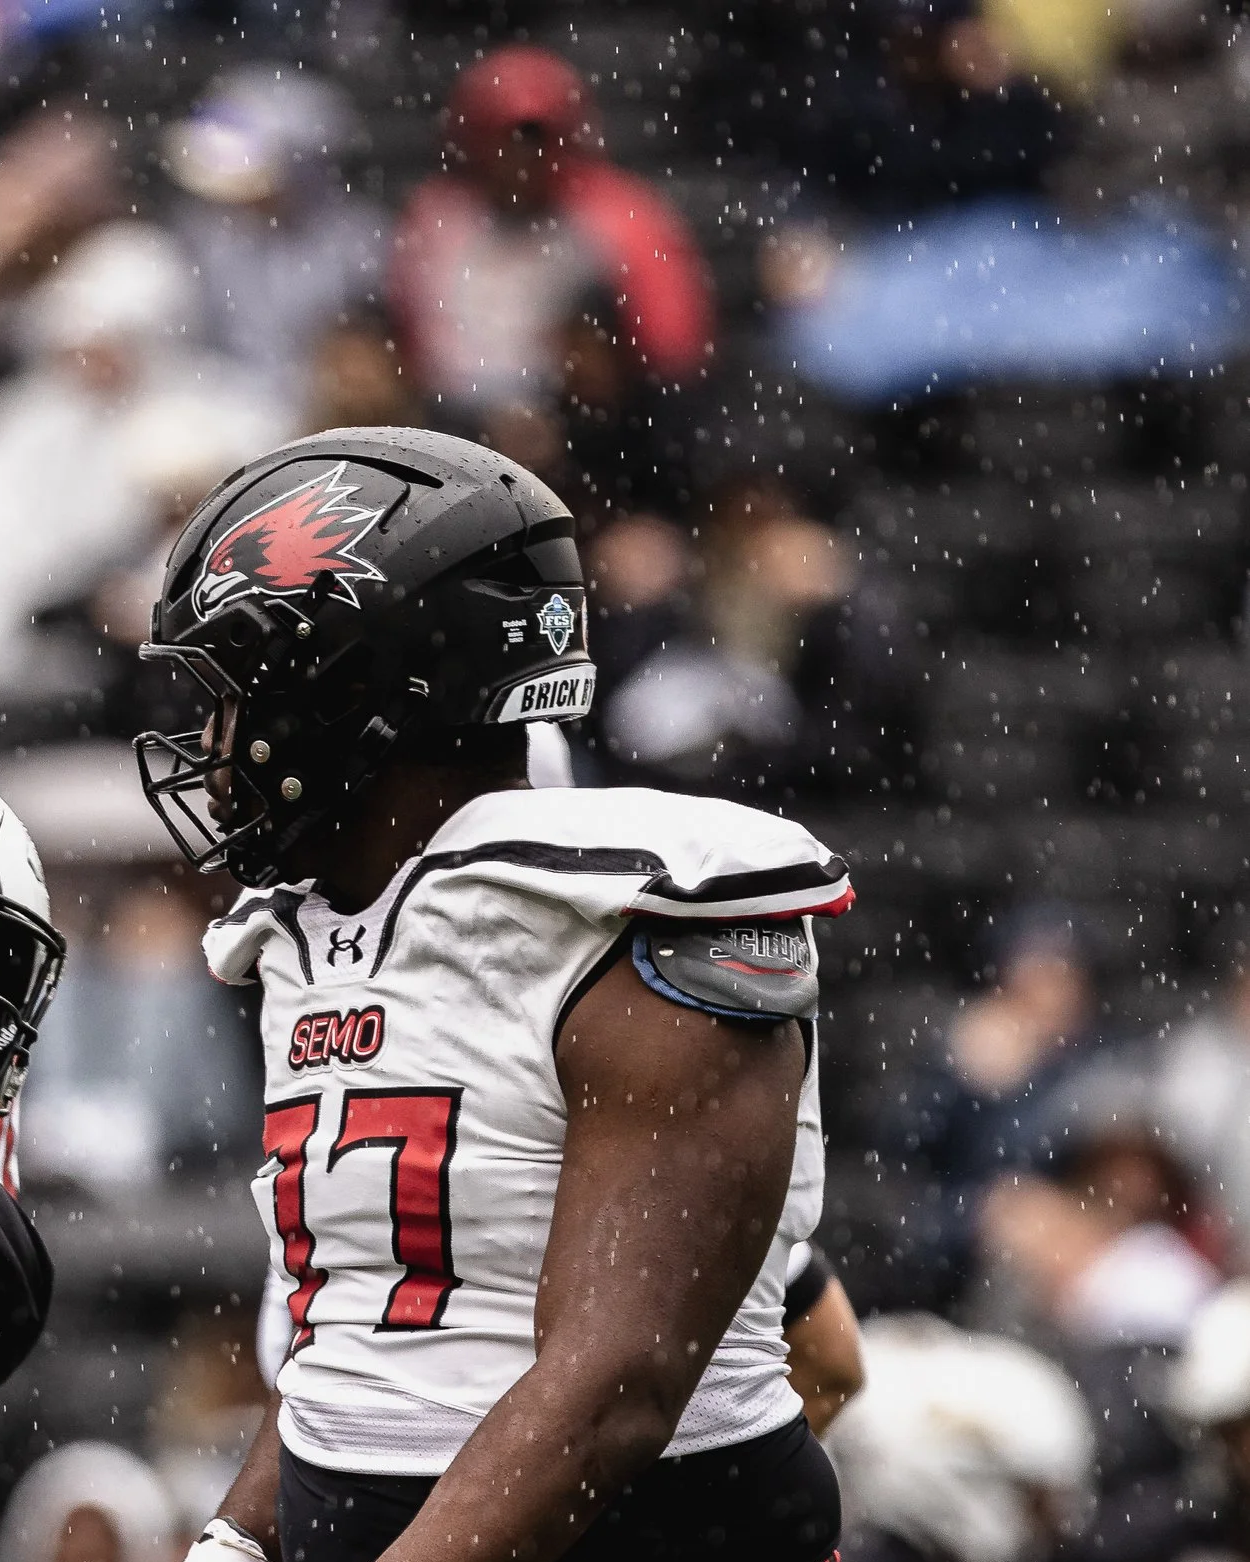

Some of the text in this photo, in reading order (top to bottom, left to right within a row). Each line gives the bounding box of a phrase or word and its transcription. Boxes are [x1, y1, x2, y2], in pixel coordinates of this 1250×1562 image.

[545, 615, 570, 626] FCS
[520, 679, 579, 713] BRICK
[289, 1004, 385, 1071] SEMO
[262, 1086, 465, 1350] 77
